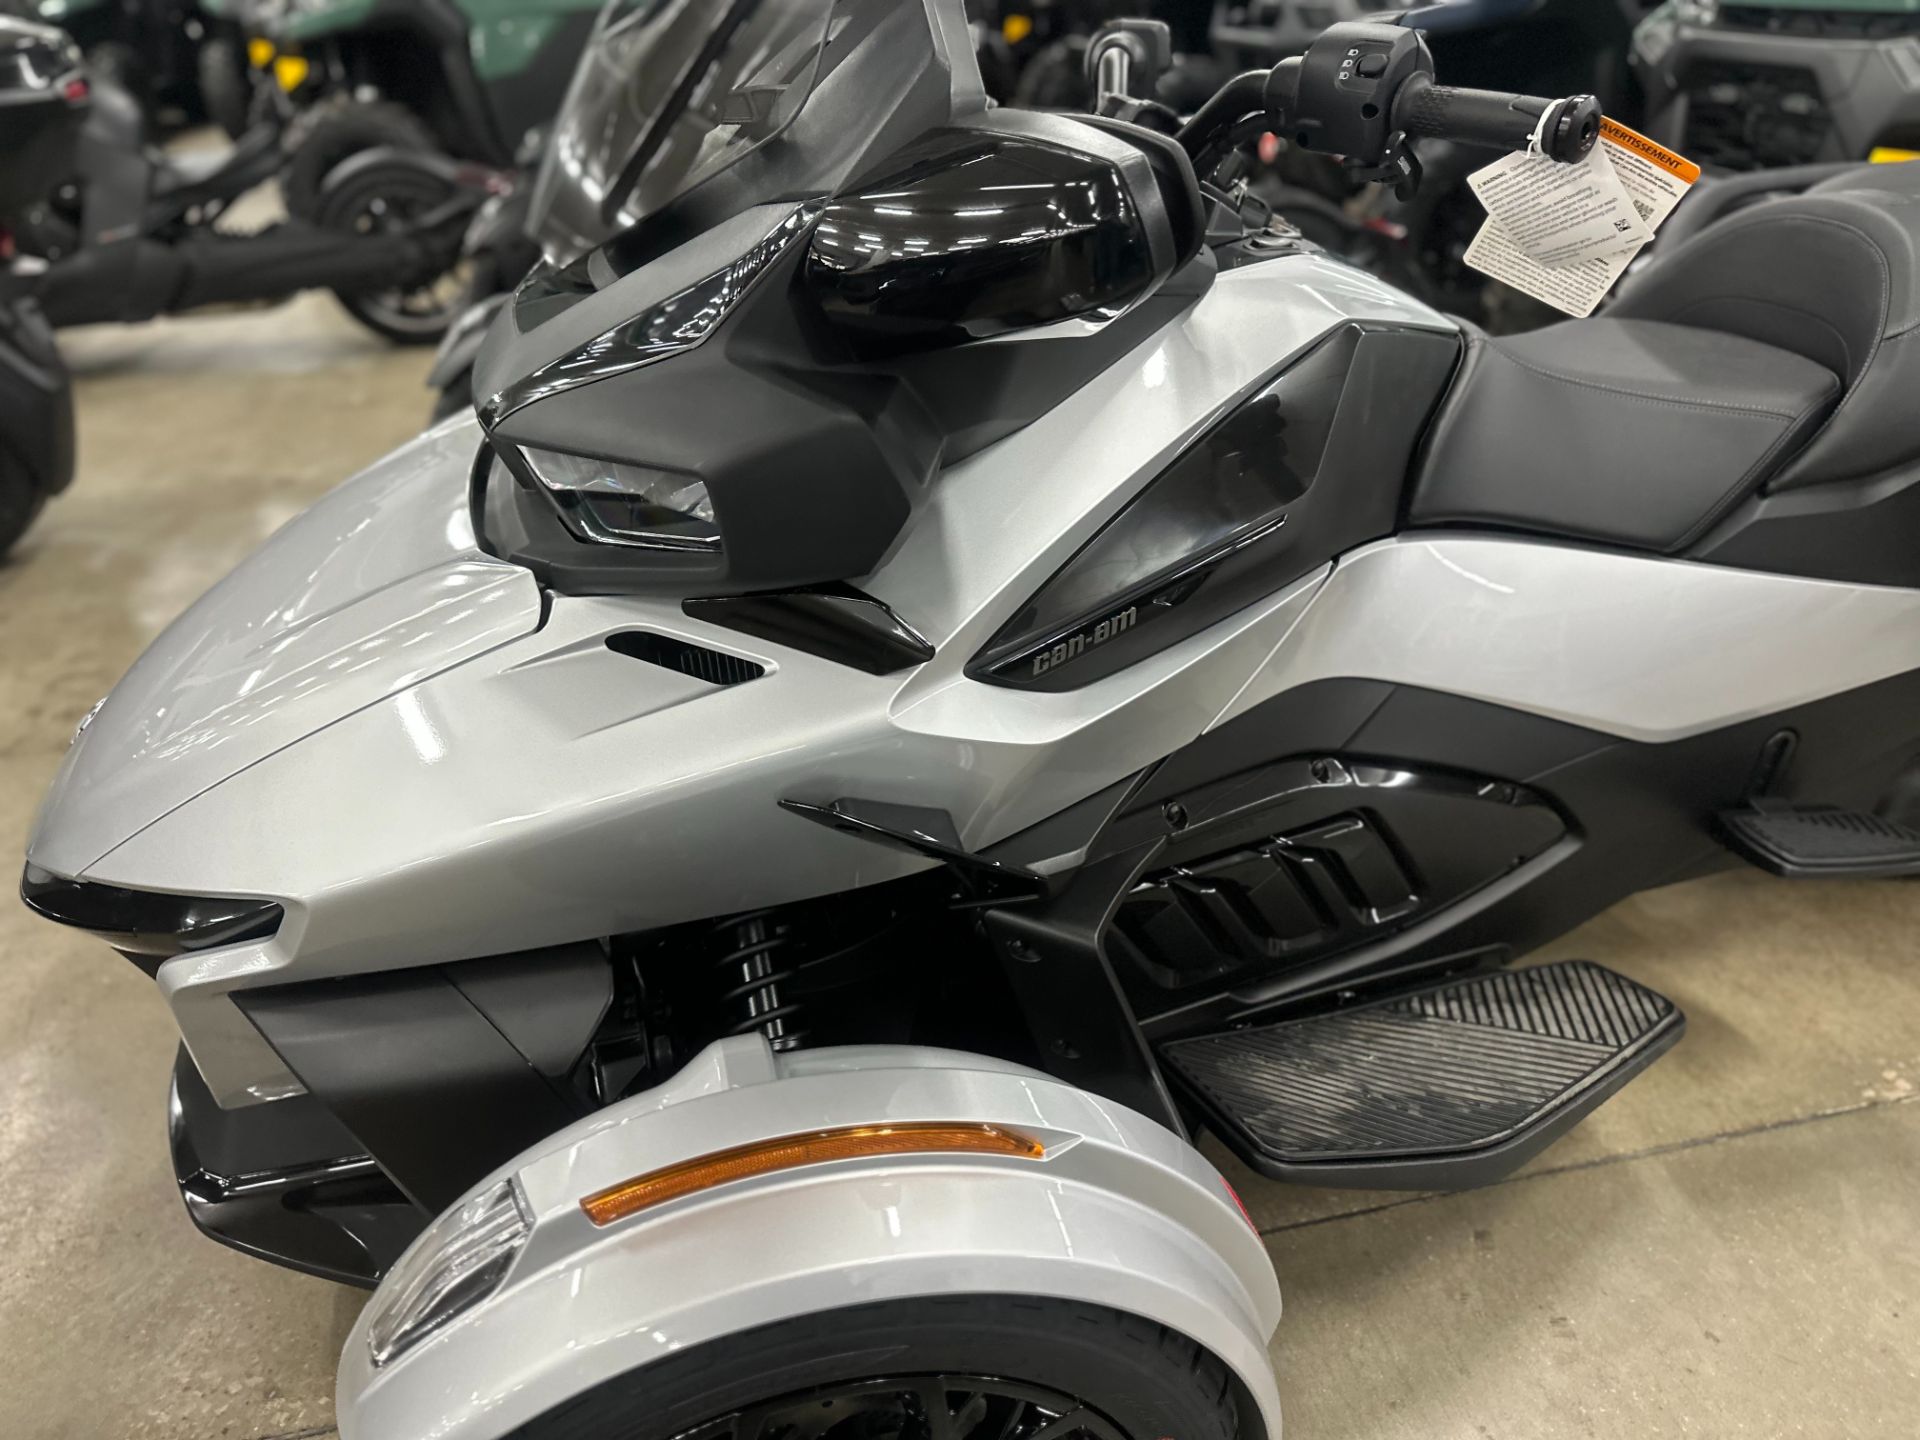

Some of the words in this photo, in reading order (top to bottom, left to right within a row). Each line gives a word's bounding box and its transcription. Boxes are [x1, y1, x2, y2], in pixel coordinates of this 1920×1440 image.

[1599, 121, 1683, 170] AVERTISSEMENT
[1552, 196, 1567, 205] avoid
[1565, 184, 1593, 200] breathing
[1033, 606, 1137, 675] can-am
